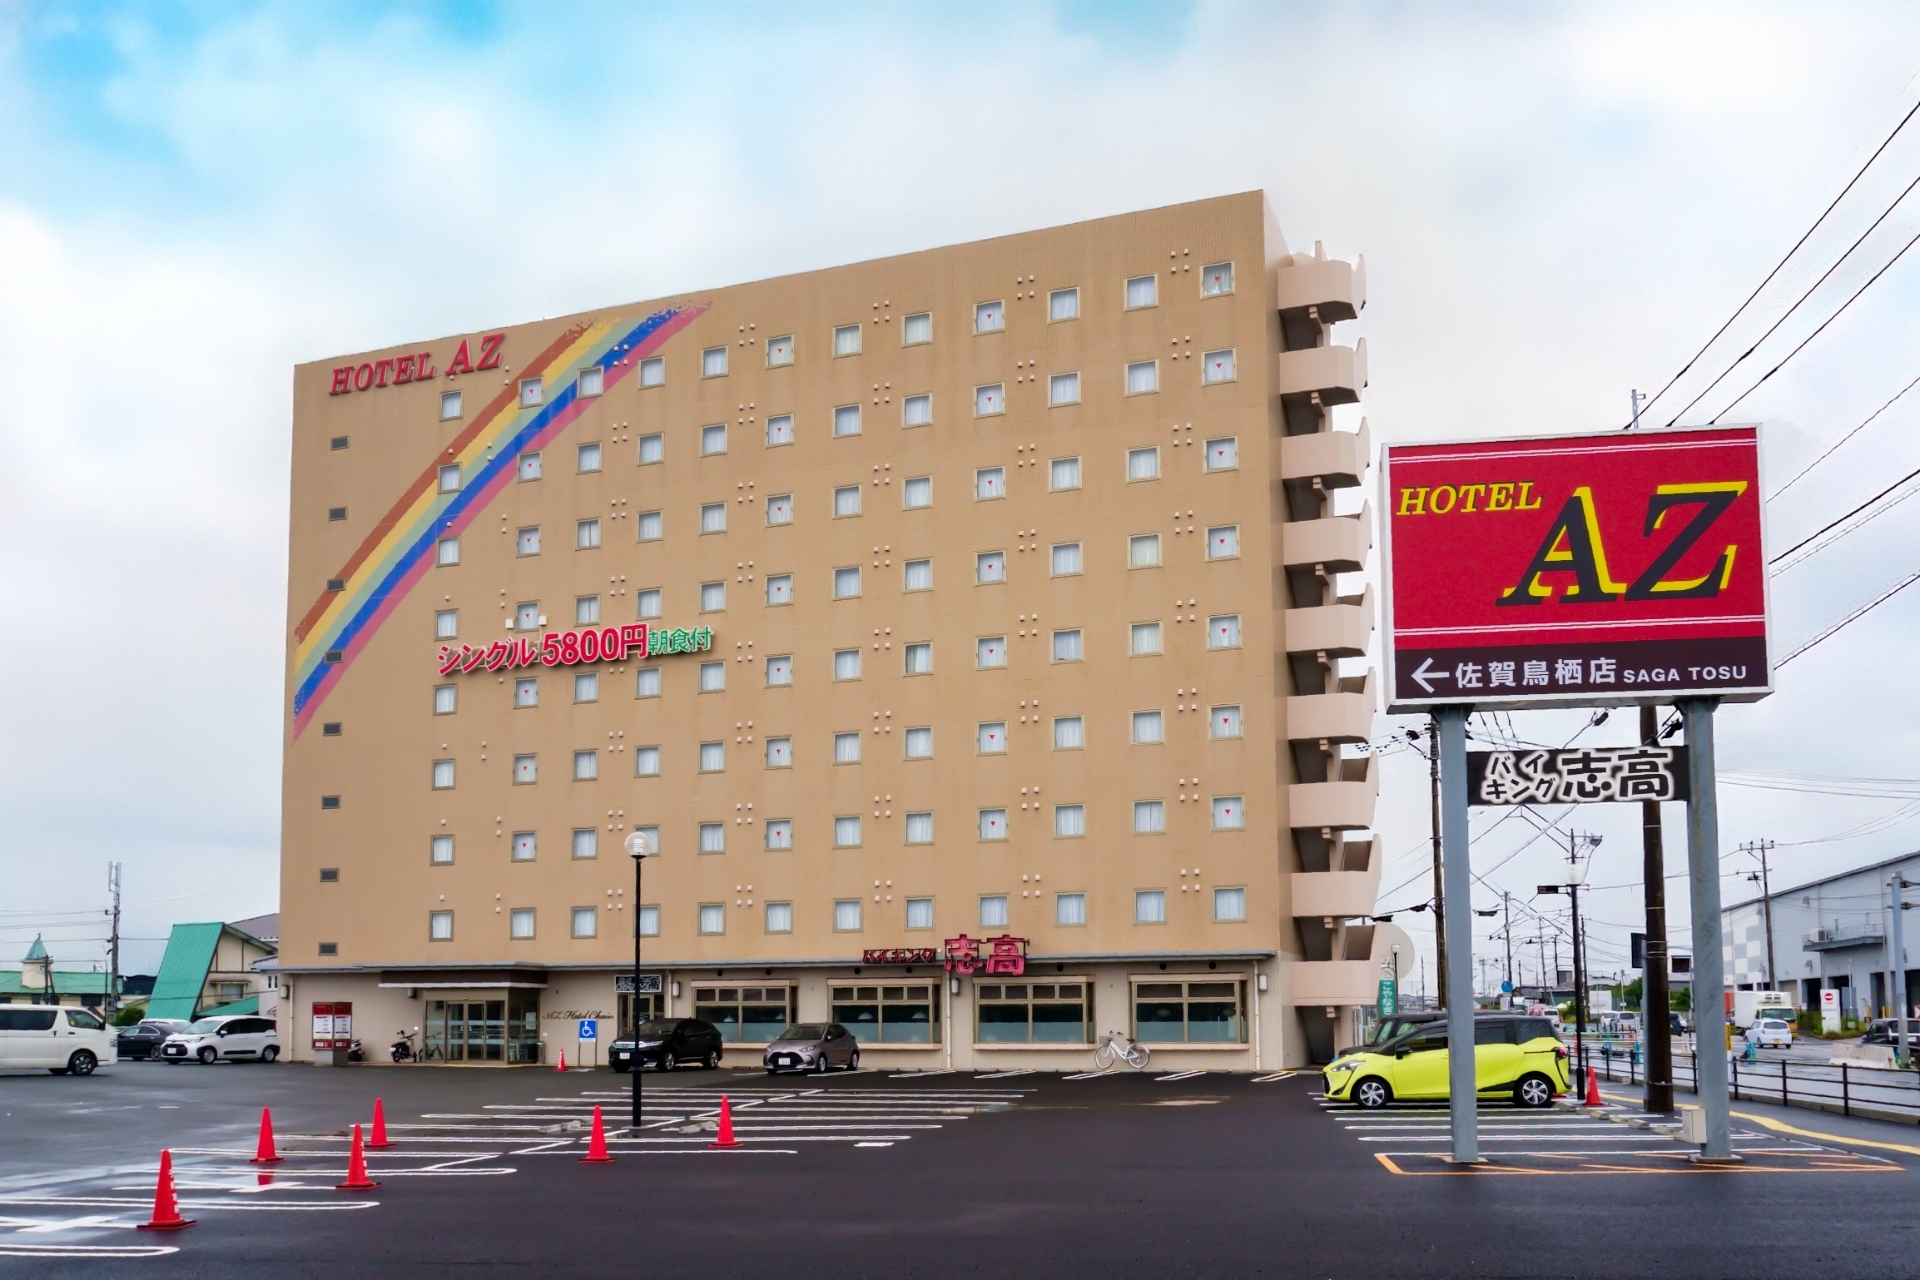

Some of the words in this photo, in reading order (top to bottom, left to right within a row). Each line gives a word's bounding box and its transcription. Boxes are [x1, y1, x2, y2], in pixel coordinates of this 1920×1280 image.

[329, 352, 436, 396] HOTEL
[445, 332, 505, 376] AZ
[1396, 481, 1543, 516] HOTEL
[1495, 481, 1749, 607] AZ
[437, 637, 535, 676] シングル
[542, 623, 650, 667] 5800円
[647, 625, 713, 656] 朝食付
[1454, 657, 1617, 688] 佐賀鳥栖店
[1623, 667, 1680, 684] SAGA
[1688, 665, 1747, 681] TOSU
[1560, 749, 1669, 799] 志高
[943, 933, 1026, 976] 志高
[563, 1009, 590, 1019] Hotel
